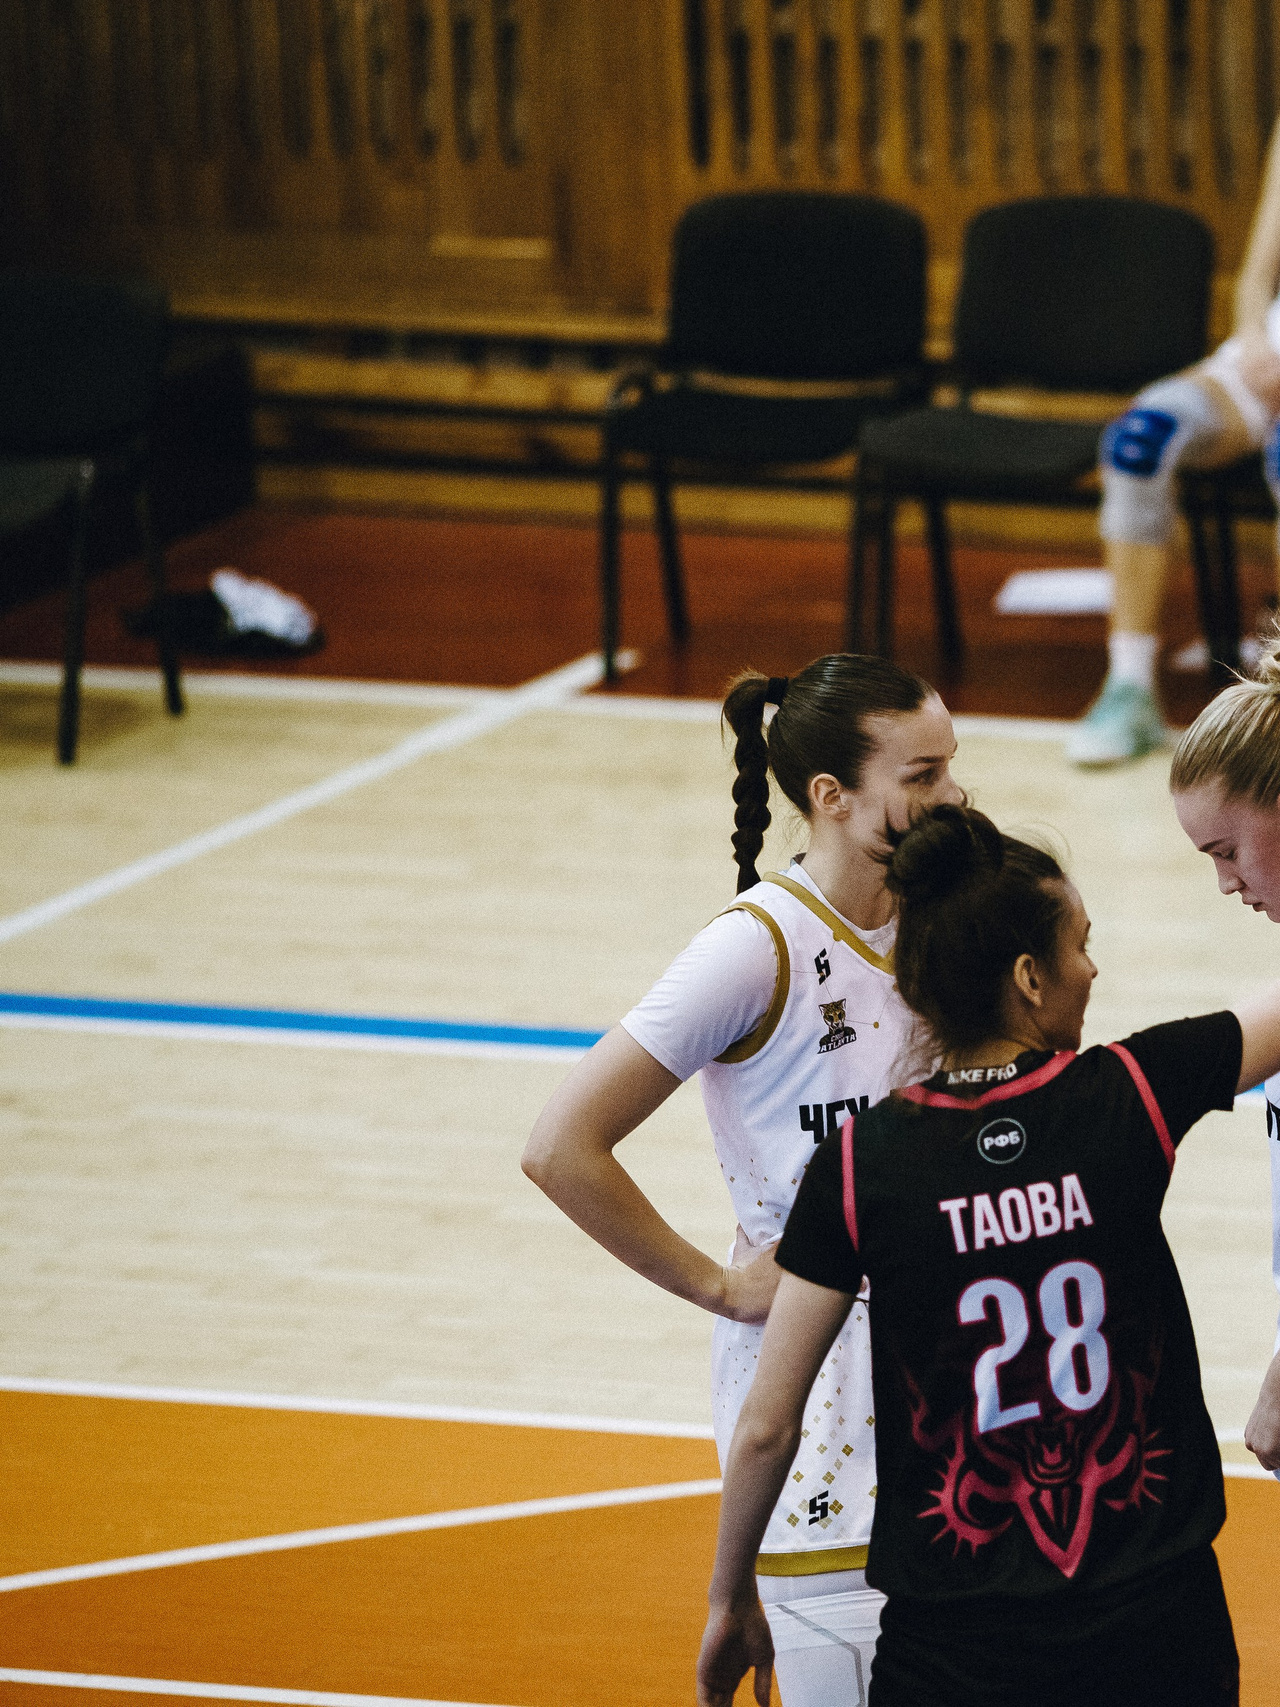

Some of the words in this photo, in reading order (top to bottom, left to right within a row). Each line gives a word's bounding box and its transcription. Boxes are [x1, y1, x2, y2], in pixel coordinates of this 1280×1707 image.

[986, 1063, 1018, 1082] PRO
[983, 1130, 1020, 1150] РФБ
[940, 1173, 1093, 1254] ТАОВА
[957, 1260, 1111, 1435] 28
